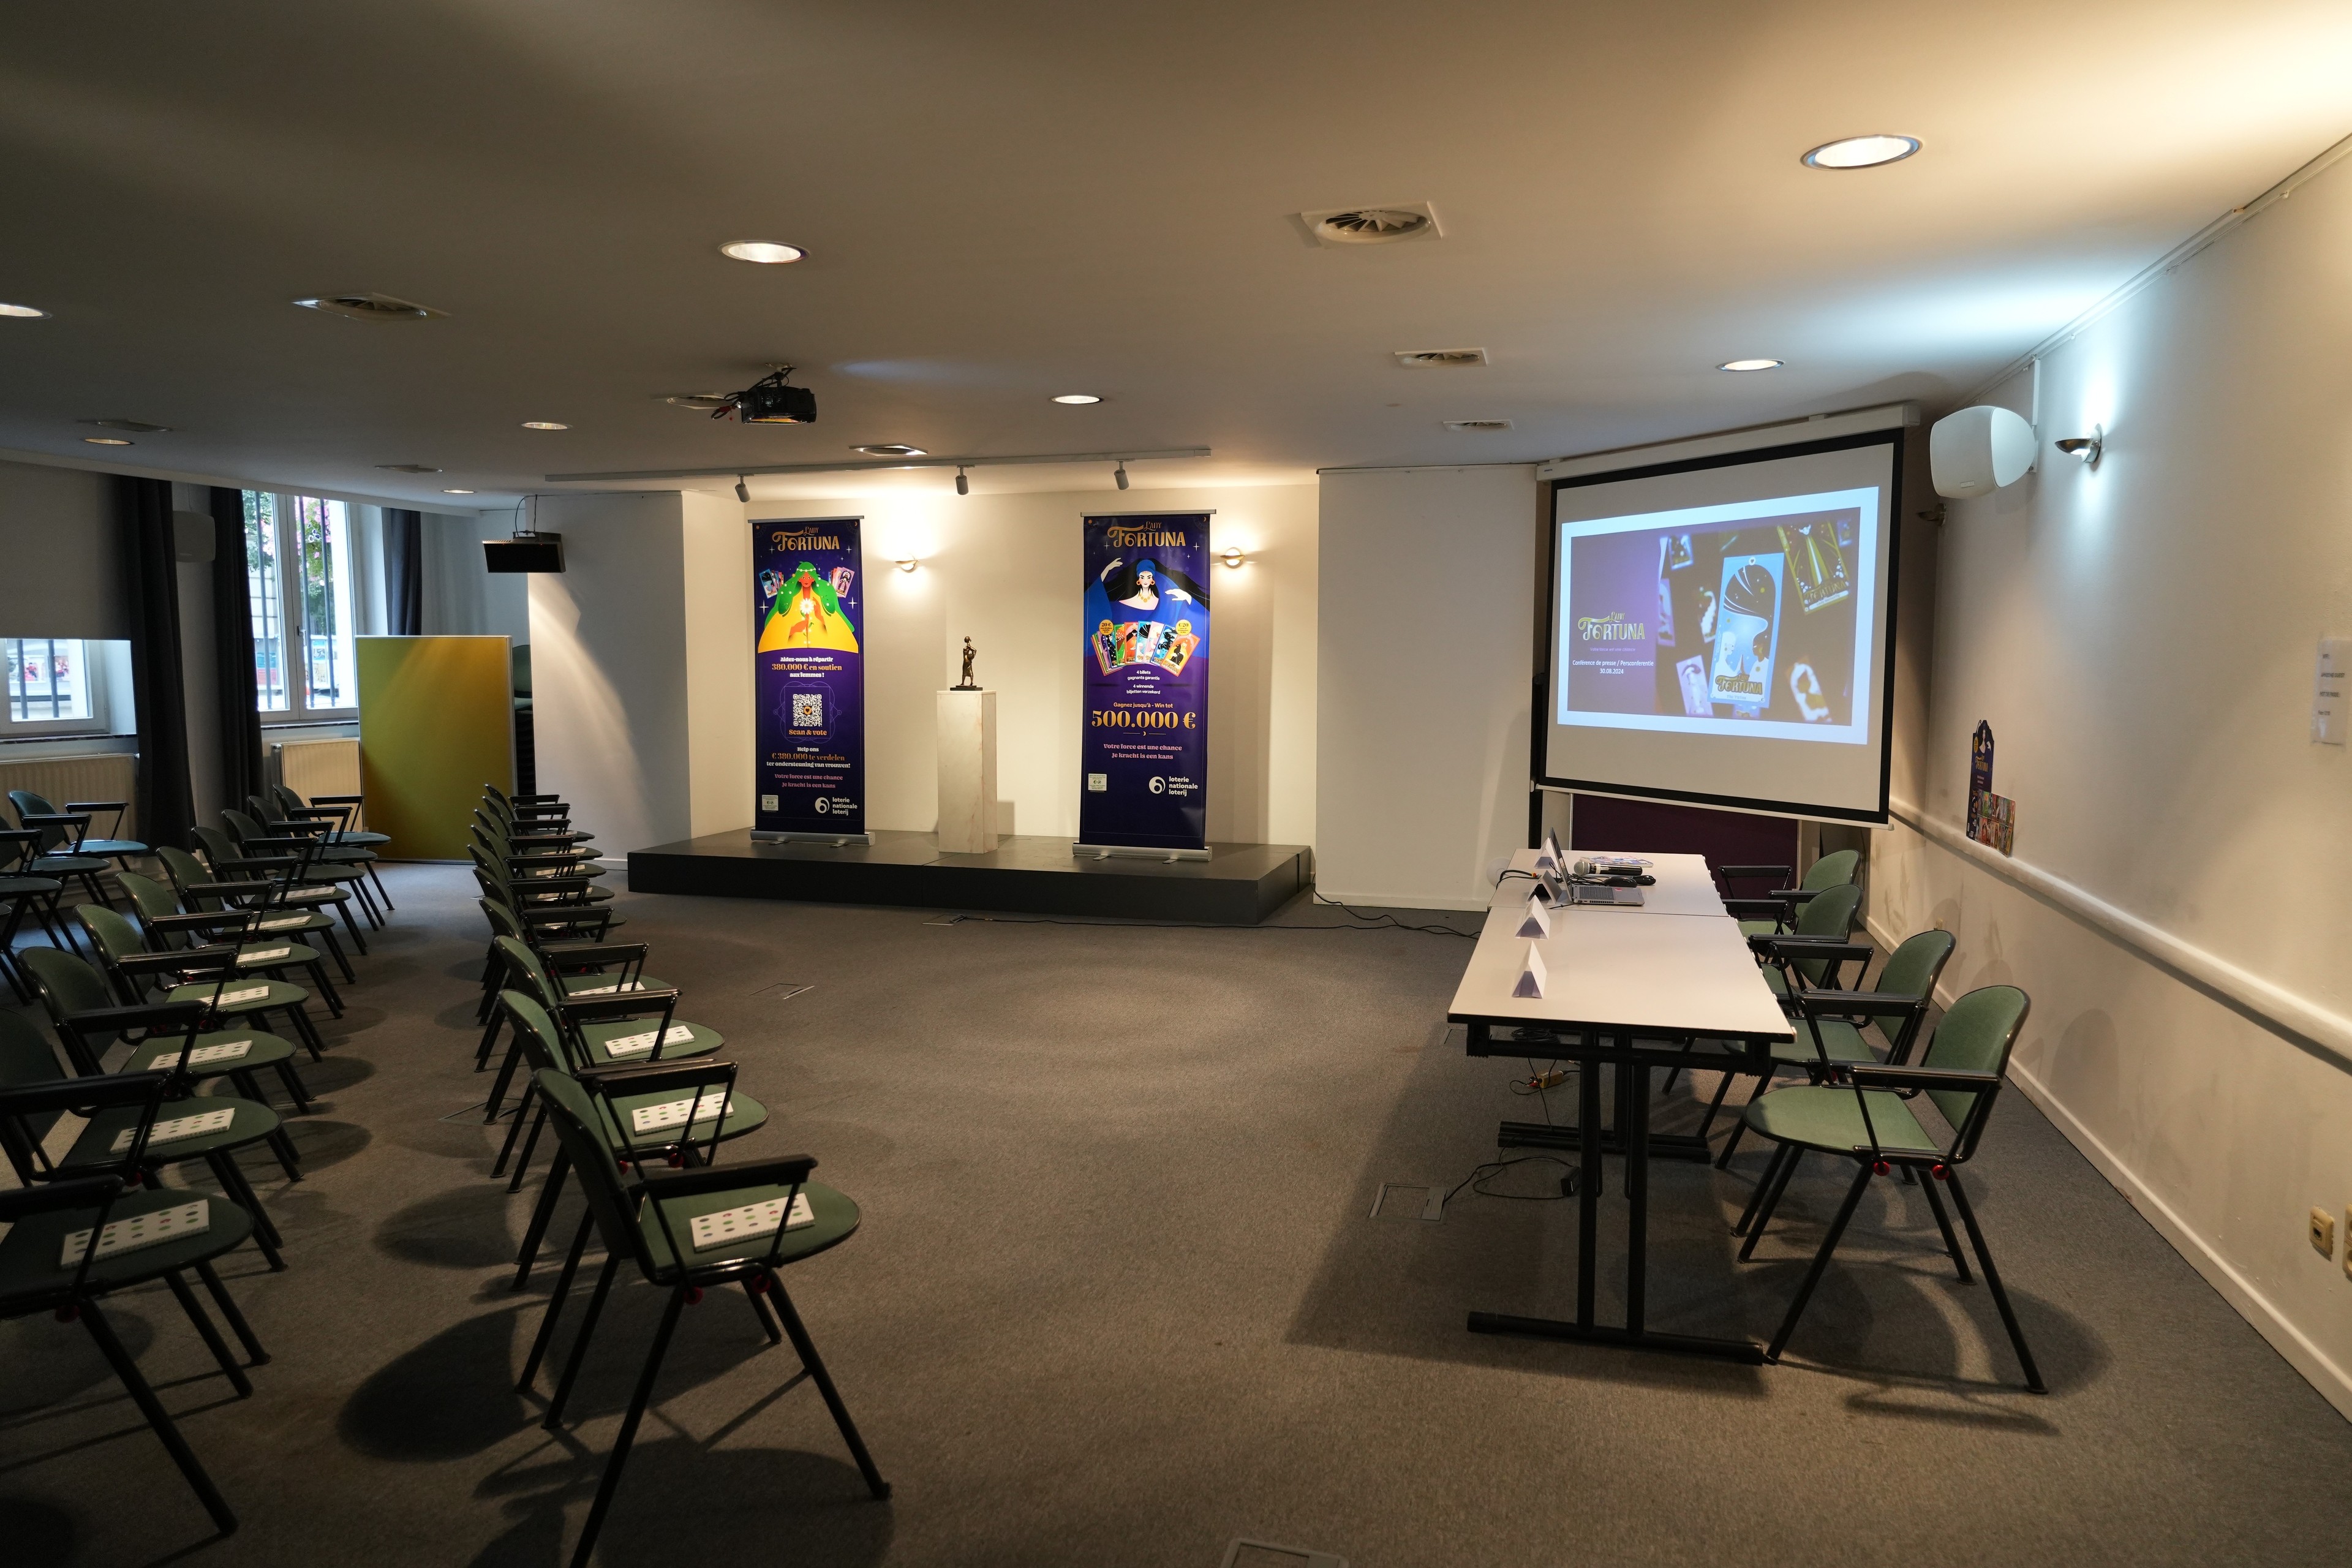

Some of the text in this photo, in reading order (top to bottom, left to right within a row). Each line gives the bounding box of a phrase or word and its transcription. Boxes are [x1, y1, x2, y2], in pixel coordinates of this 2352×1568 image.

[772, 530, 840, 551] FORTUNA
[1107, 524, 1186, 547] FORTUNA
[1578, 615, 1645, 641] FORTUNA
[1715, 675, 1763, 695] FORTUNA
[1091, 710, 1196, 729] 500.000 €
